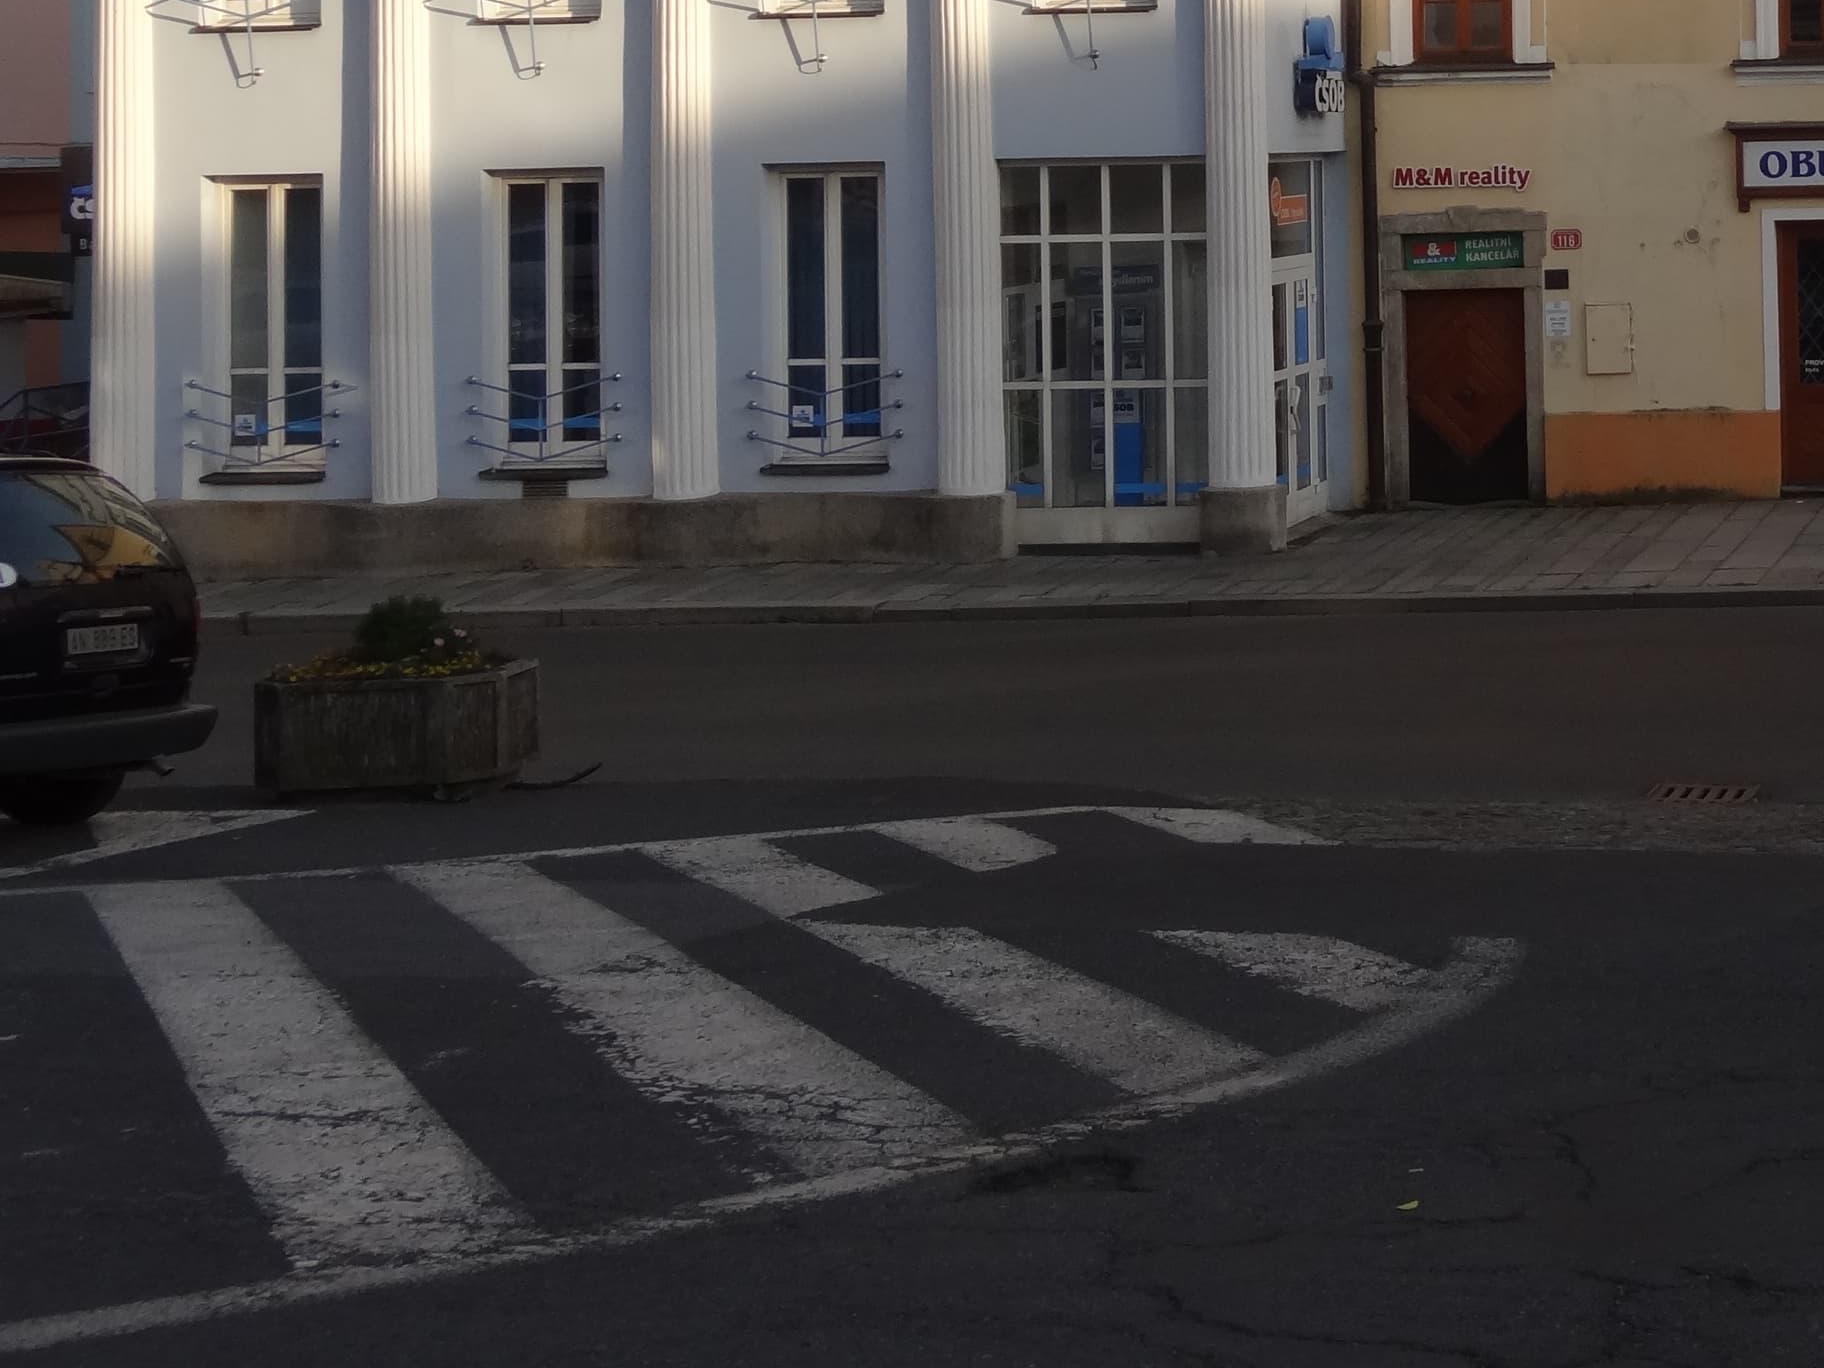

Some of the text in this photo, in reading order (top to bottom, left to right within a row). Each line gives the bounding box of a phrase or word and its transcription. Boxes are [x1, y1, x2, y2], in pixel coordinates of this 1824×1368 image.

[1315, 74, 1345, 113] ČSOB
[1394, 165, 1531, 190] M&M reality
